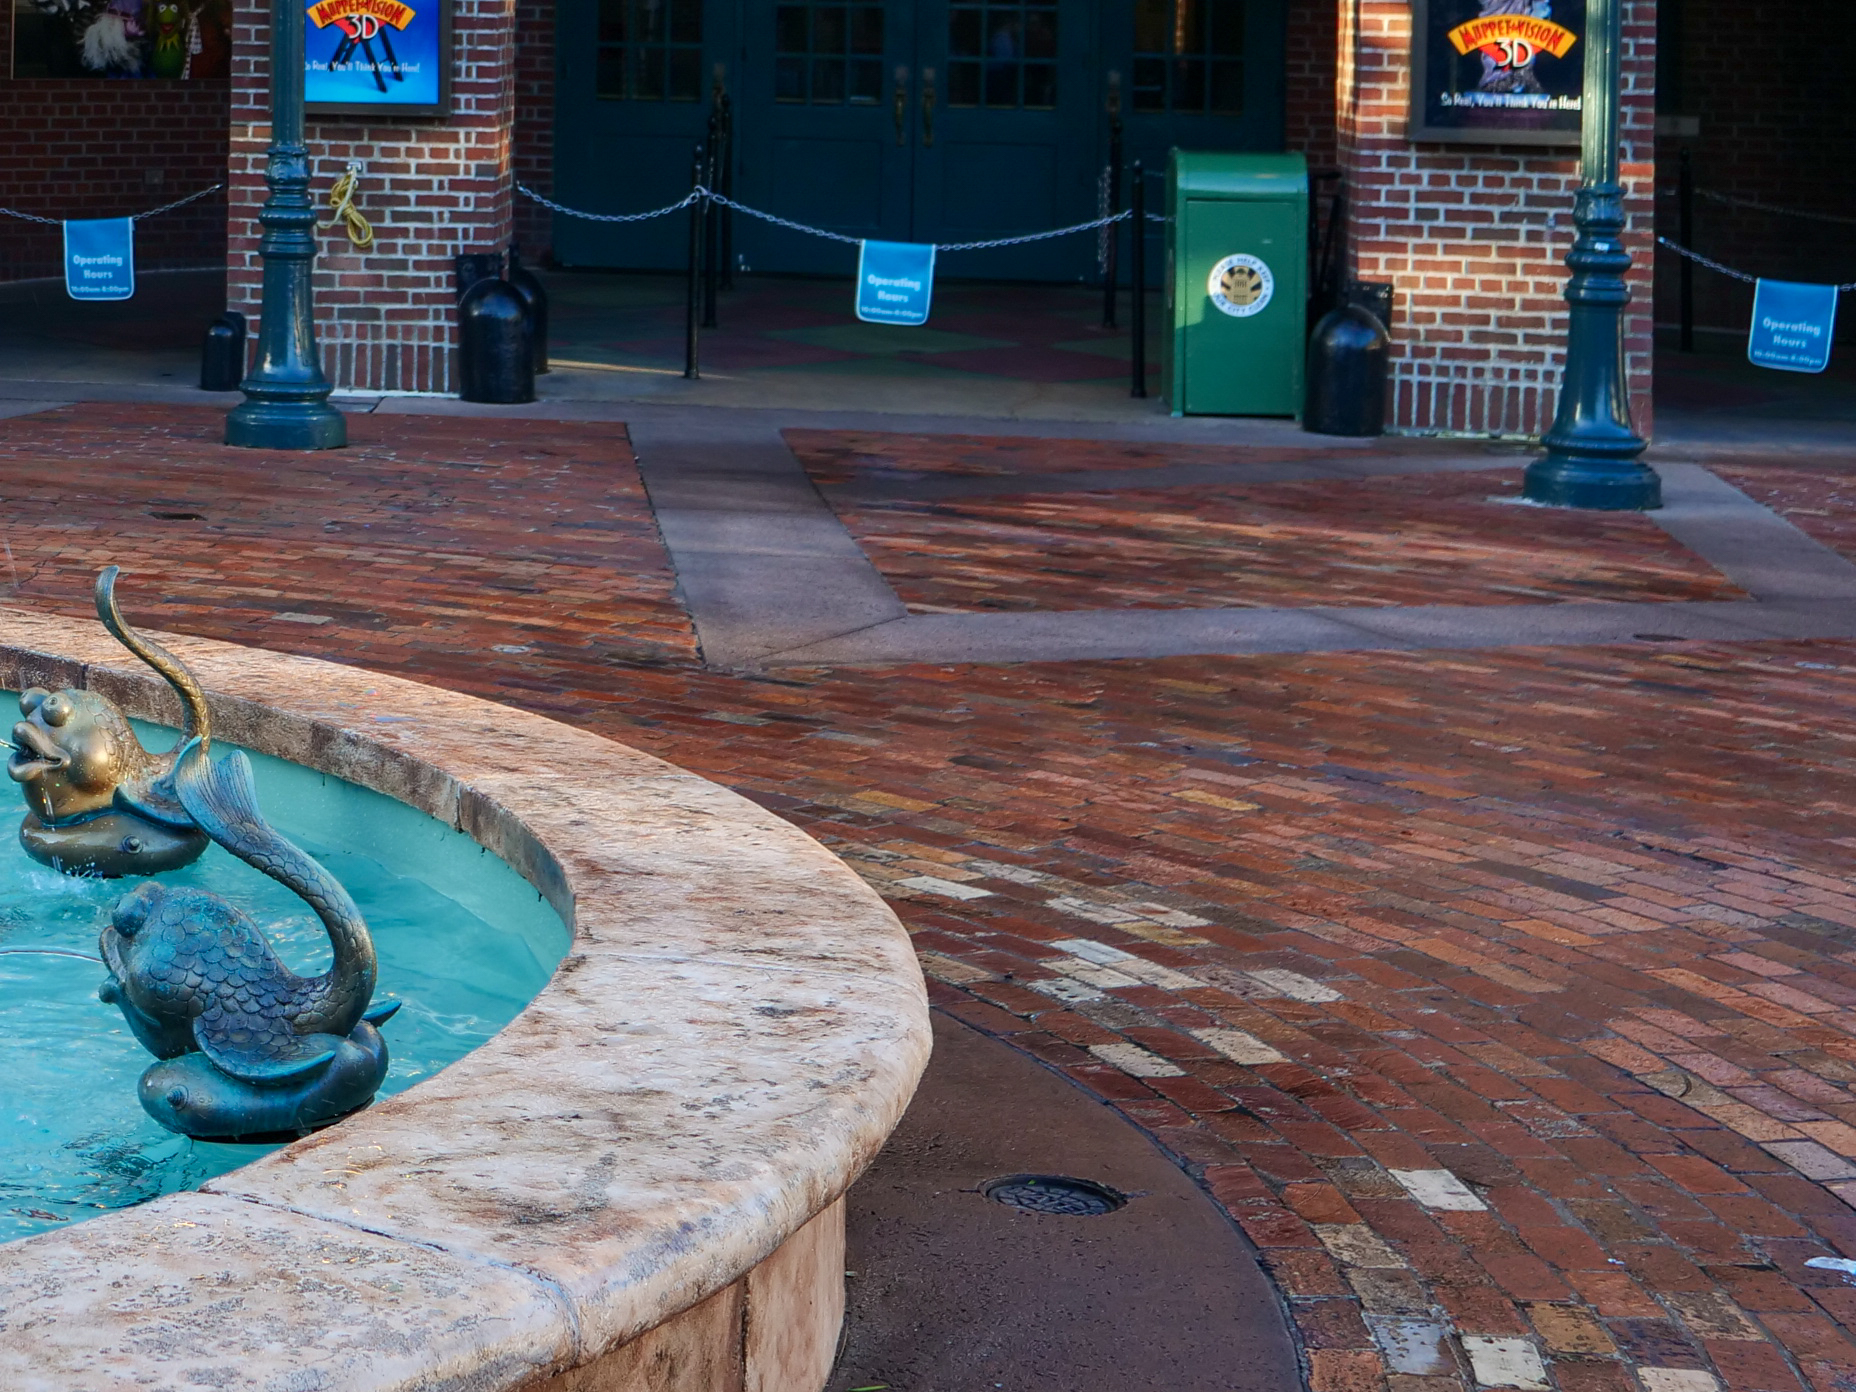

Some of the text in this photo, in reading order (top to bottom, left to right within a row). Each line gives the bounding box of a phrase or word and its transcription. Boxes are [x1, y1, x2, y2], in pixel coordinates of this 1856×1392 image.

[348, 14, 379, 40] 3D
[1496, 37, 1533, 68] 3D
[1441, 91, 1452, 107] So
[73, 254, 123, 267] Operating
[83, 269, 113, 279] Hours
[867, 274, 921, 291] Operating
[877, 290, 909, 303] Hours
[1762, 316, 1821, 338] Operating
[1773, 334, 1807, 349] Hours
